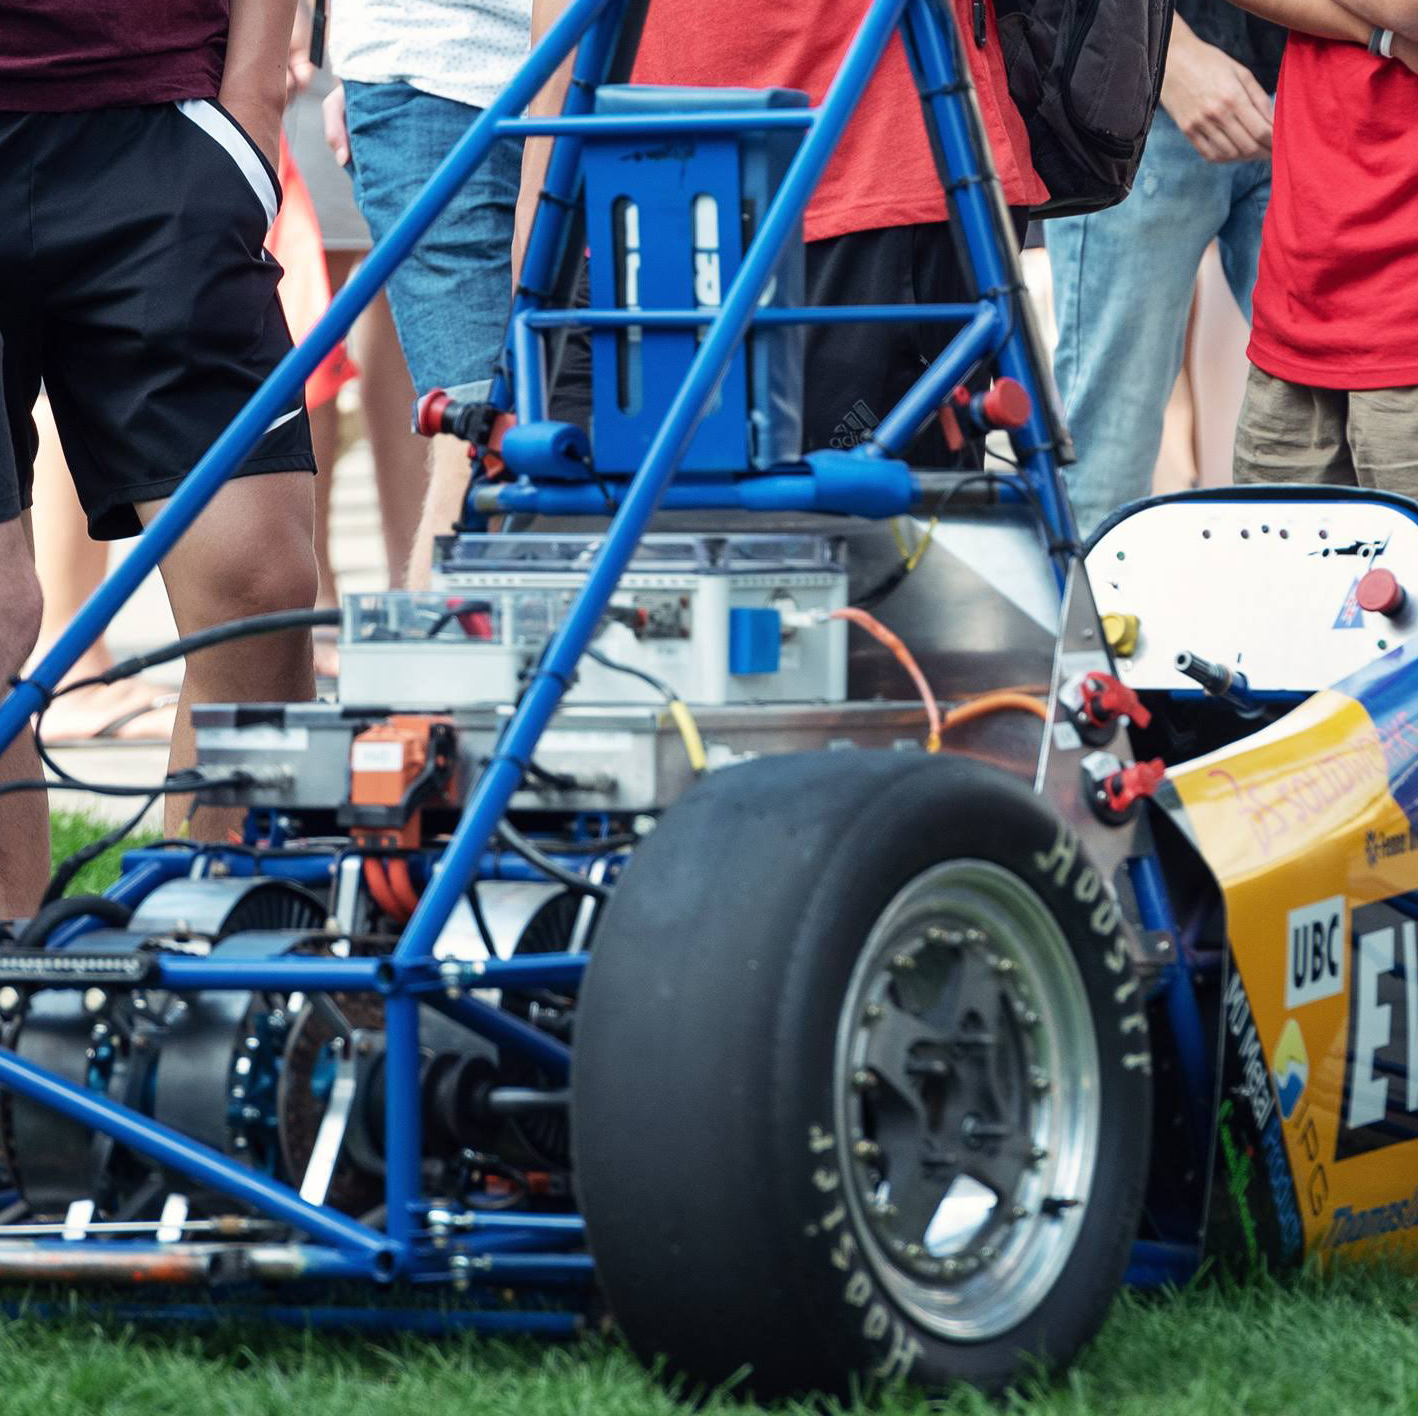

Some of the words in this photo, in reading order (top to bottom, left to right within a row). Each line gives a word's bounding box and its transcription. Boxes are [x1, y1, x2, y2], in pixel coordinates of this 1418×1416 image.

[1034, 823, 1152, 1074] Hoosier
[1292, 912, 1340, 990] UBC
[1292, 1098, 1329, 1218] IPG
